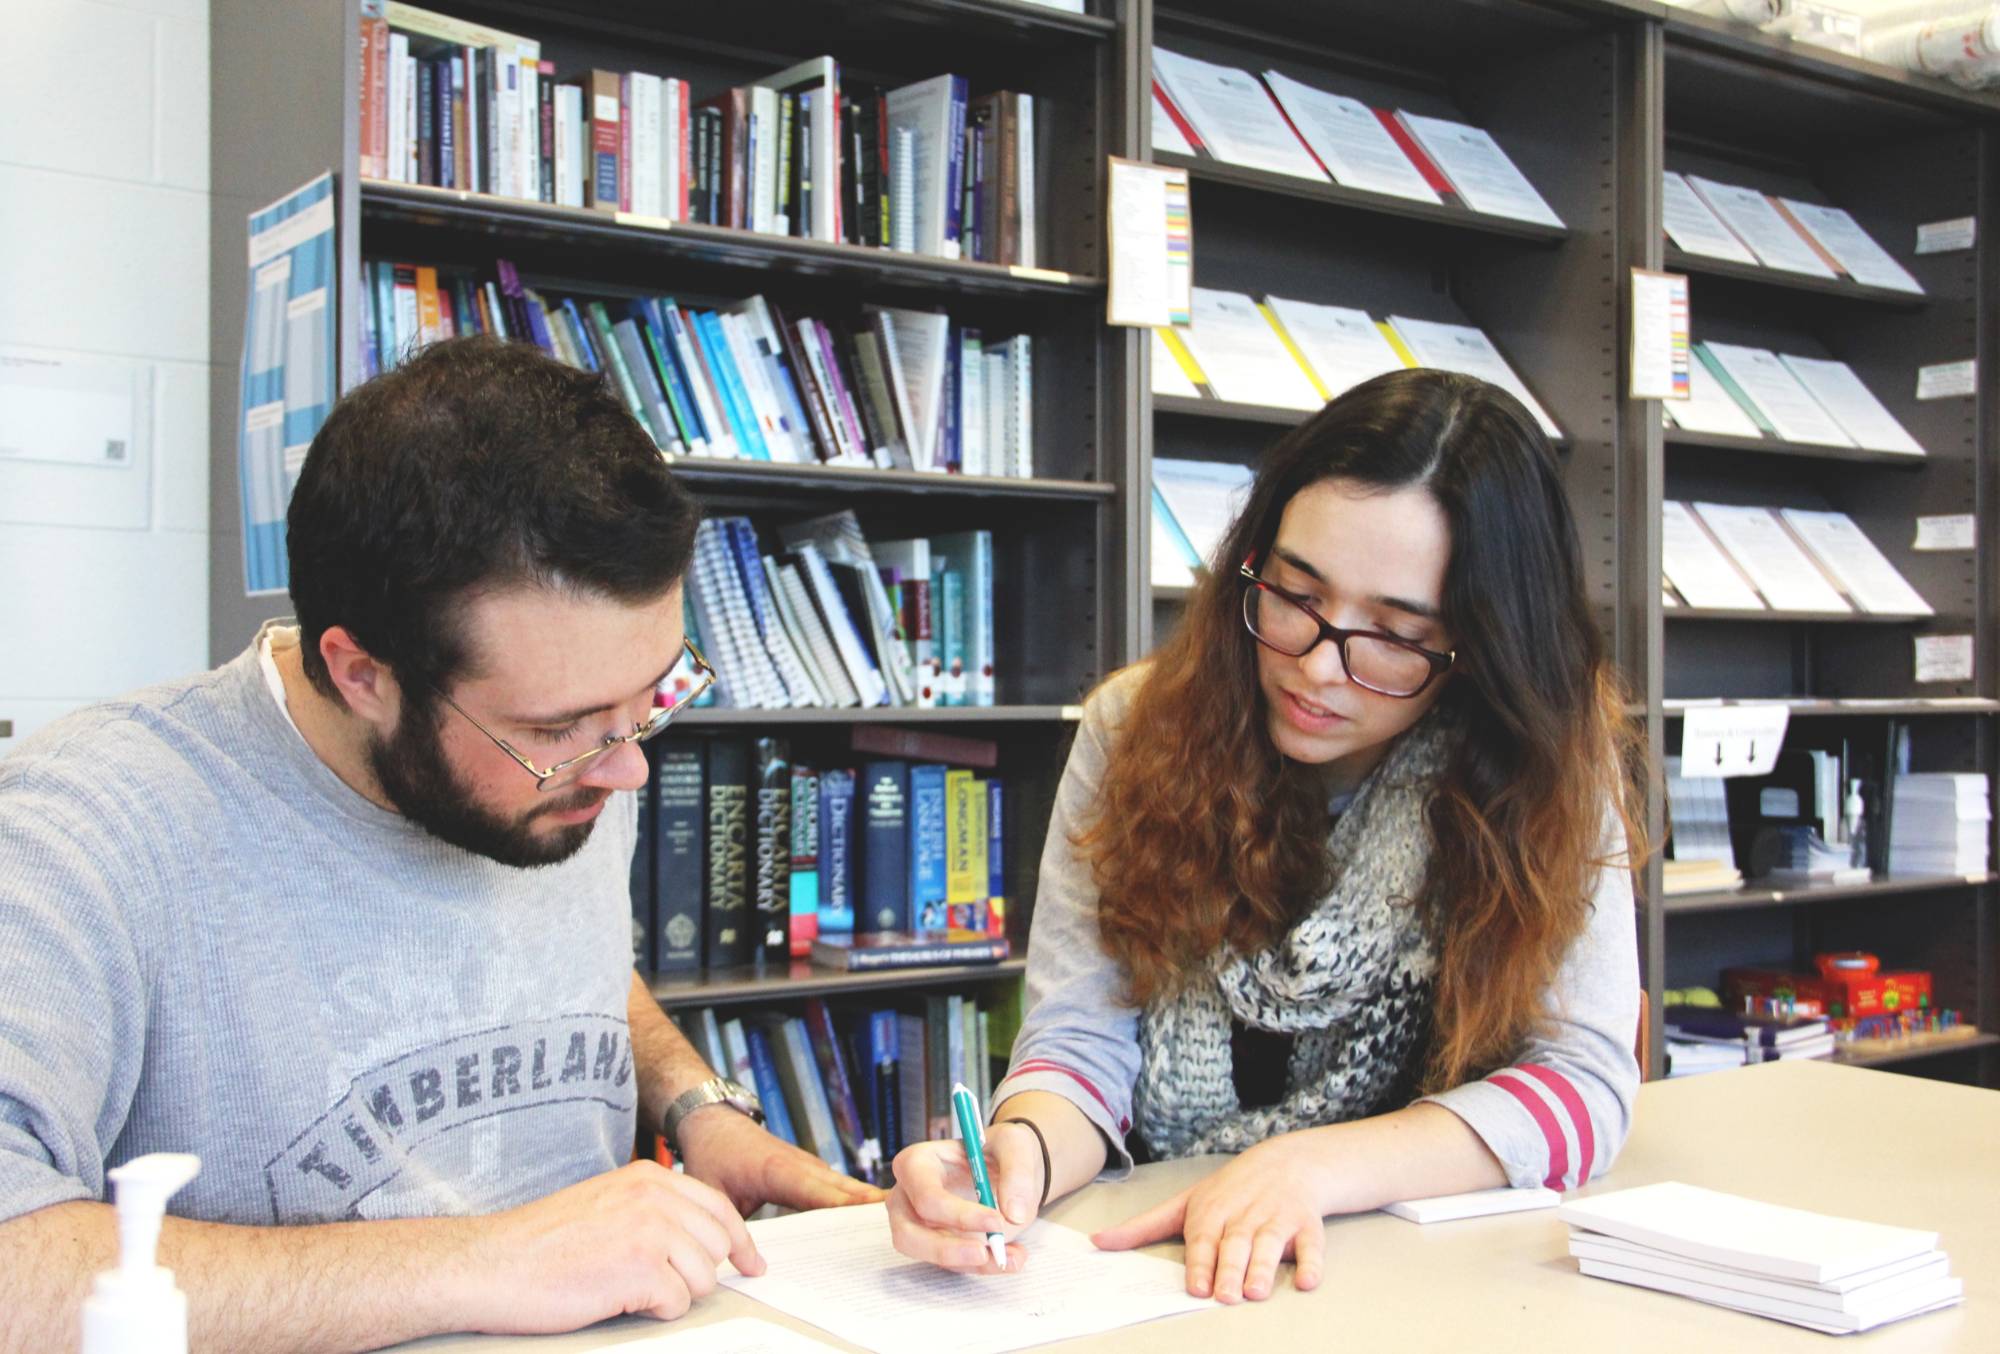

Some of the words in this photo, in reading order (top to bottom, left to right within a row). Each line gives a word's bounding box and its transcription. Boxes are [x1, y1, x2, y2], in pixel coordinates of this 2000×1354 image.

[709, 784, 727, 909] DICTIONARY
[725, 785, 746, 911] ENCARTA
[757, 788, 775, 909] DICTIONARY
[772, 788, 788, 912] ENCARTA
[829, 797, 847, 916] DICTIONARY
[957, 775, 970, 872] LONGMAN
